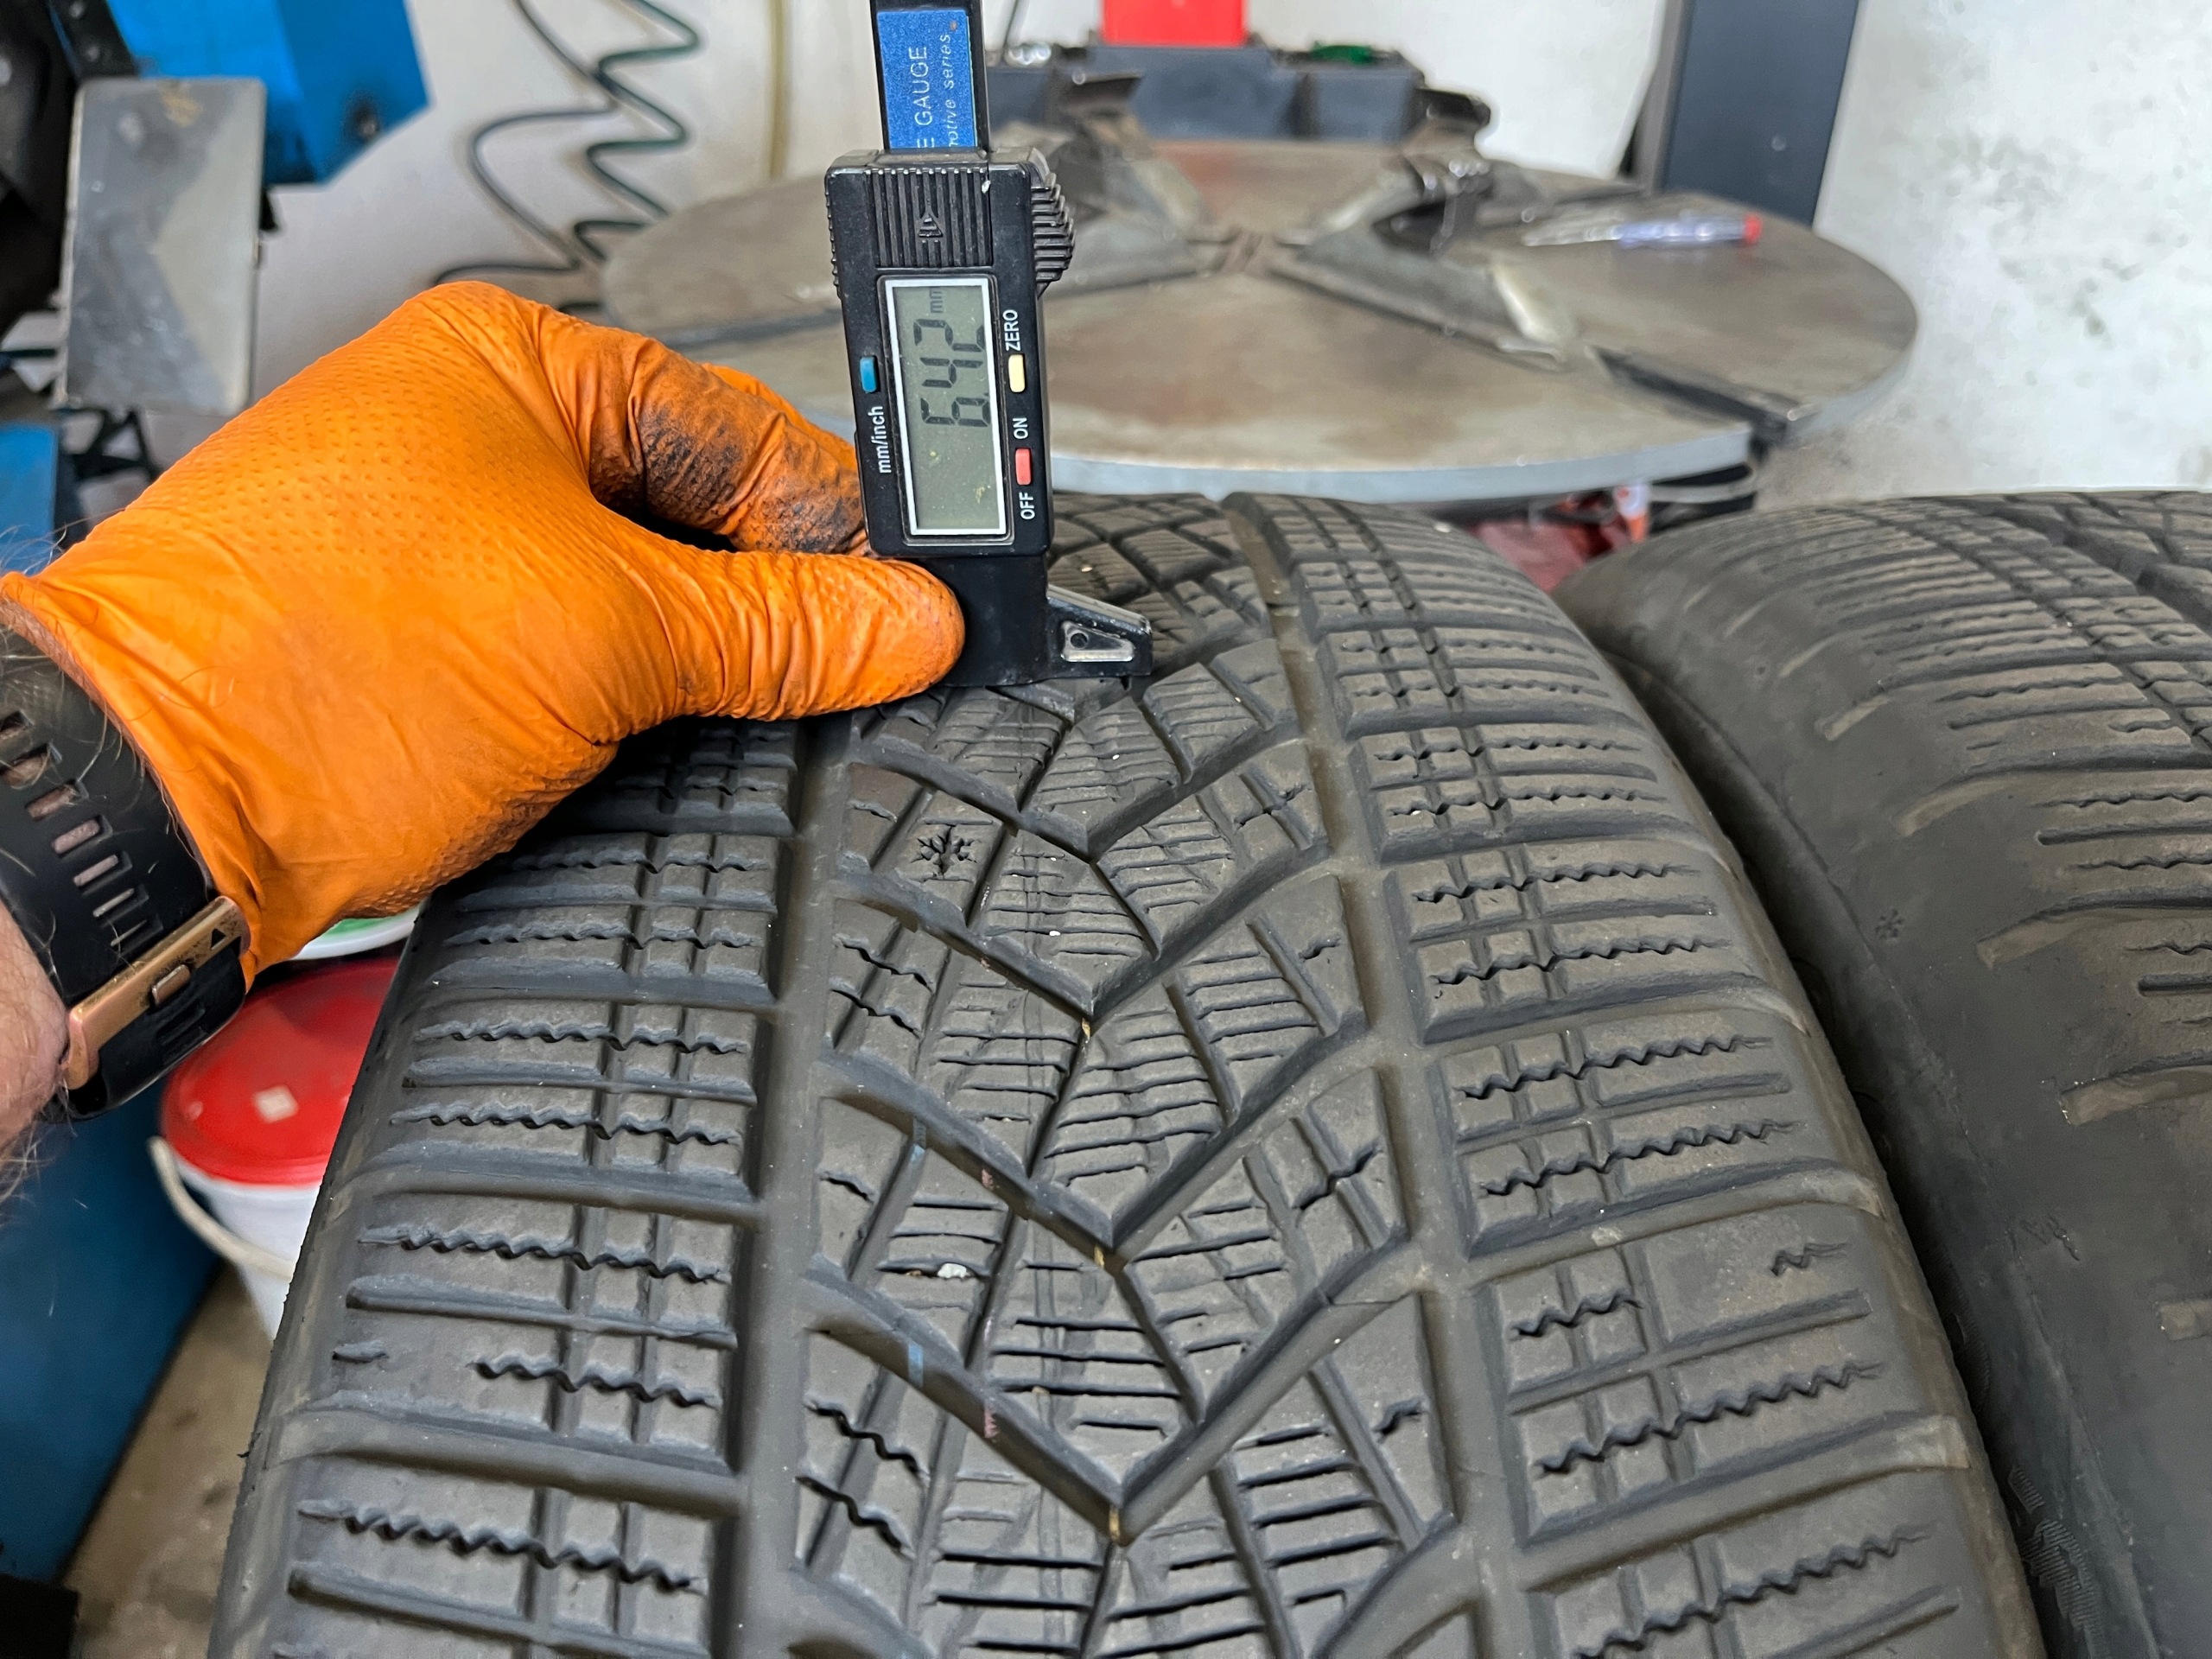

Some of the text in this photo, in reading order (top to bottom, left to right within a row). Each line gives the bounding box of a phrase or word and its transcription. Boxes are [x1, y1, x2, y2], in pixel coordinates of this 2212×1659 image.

[909, 47, 933, 125] GAUGE
[939, 34, 954, 90] series
[1002, 308, 1021, 352] ZERO
[912, 318, 990, 428] 6.42
[868, 405, 892, 474] mm/inch
[1012, 416, 1029, 440] ON
[1018, 492, 1036, 520] OFF
